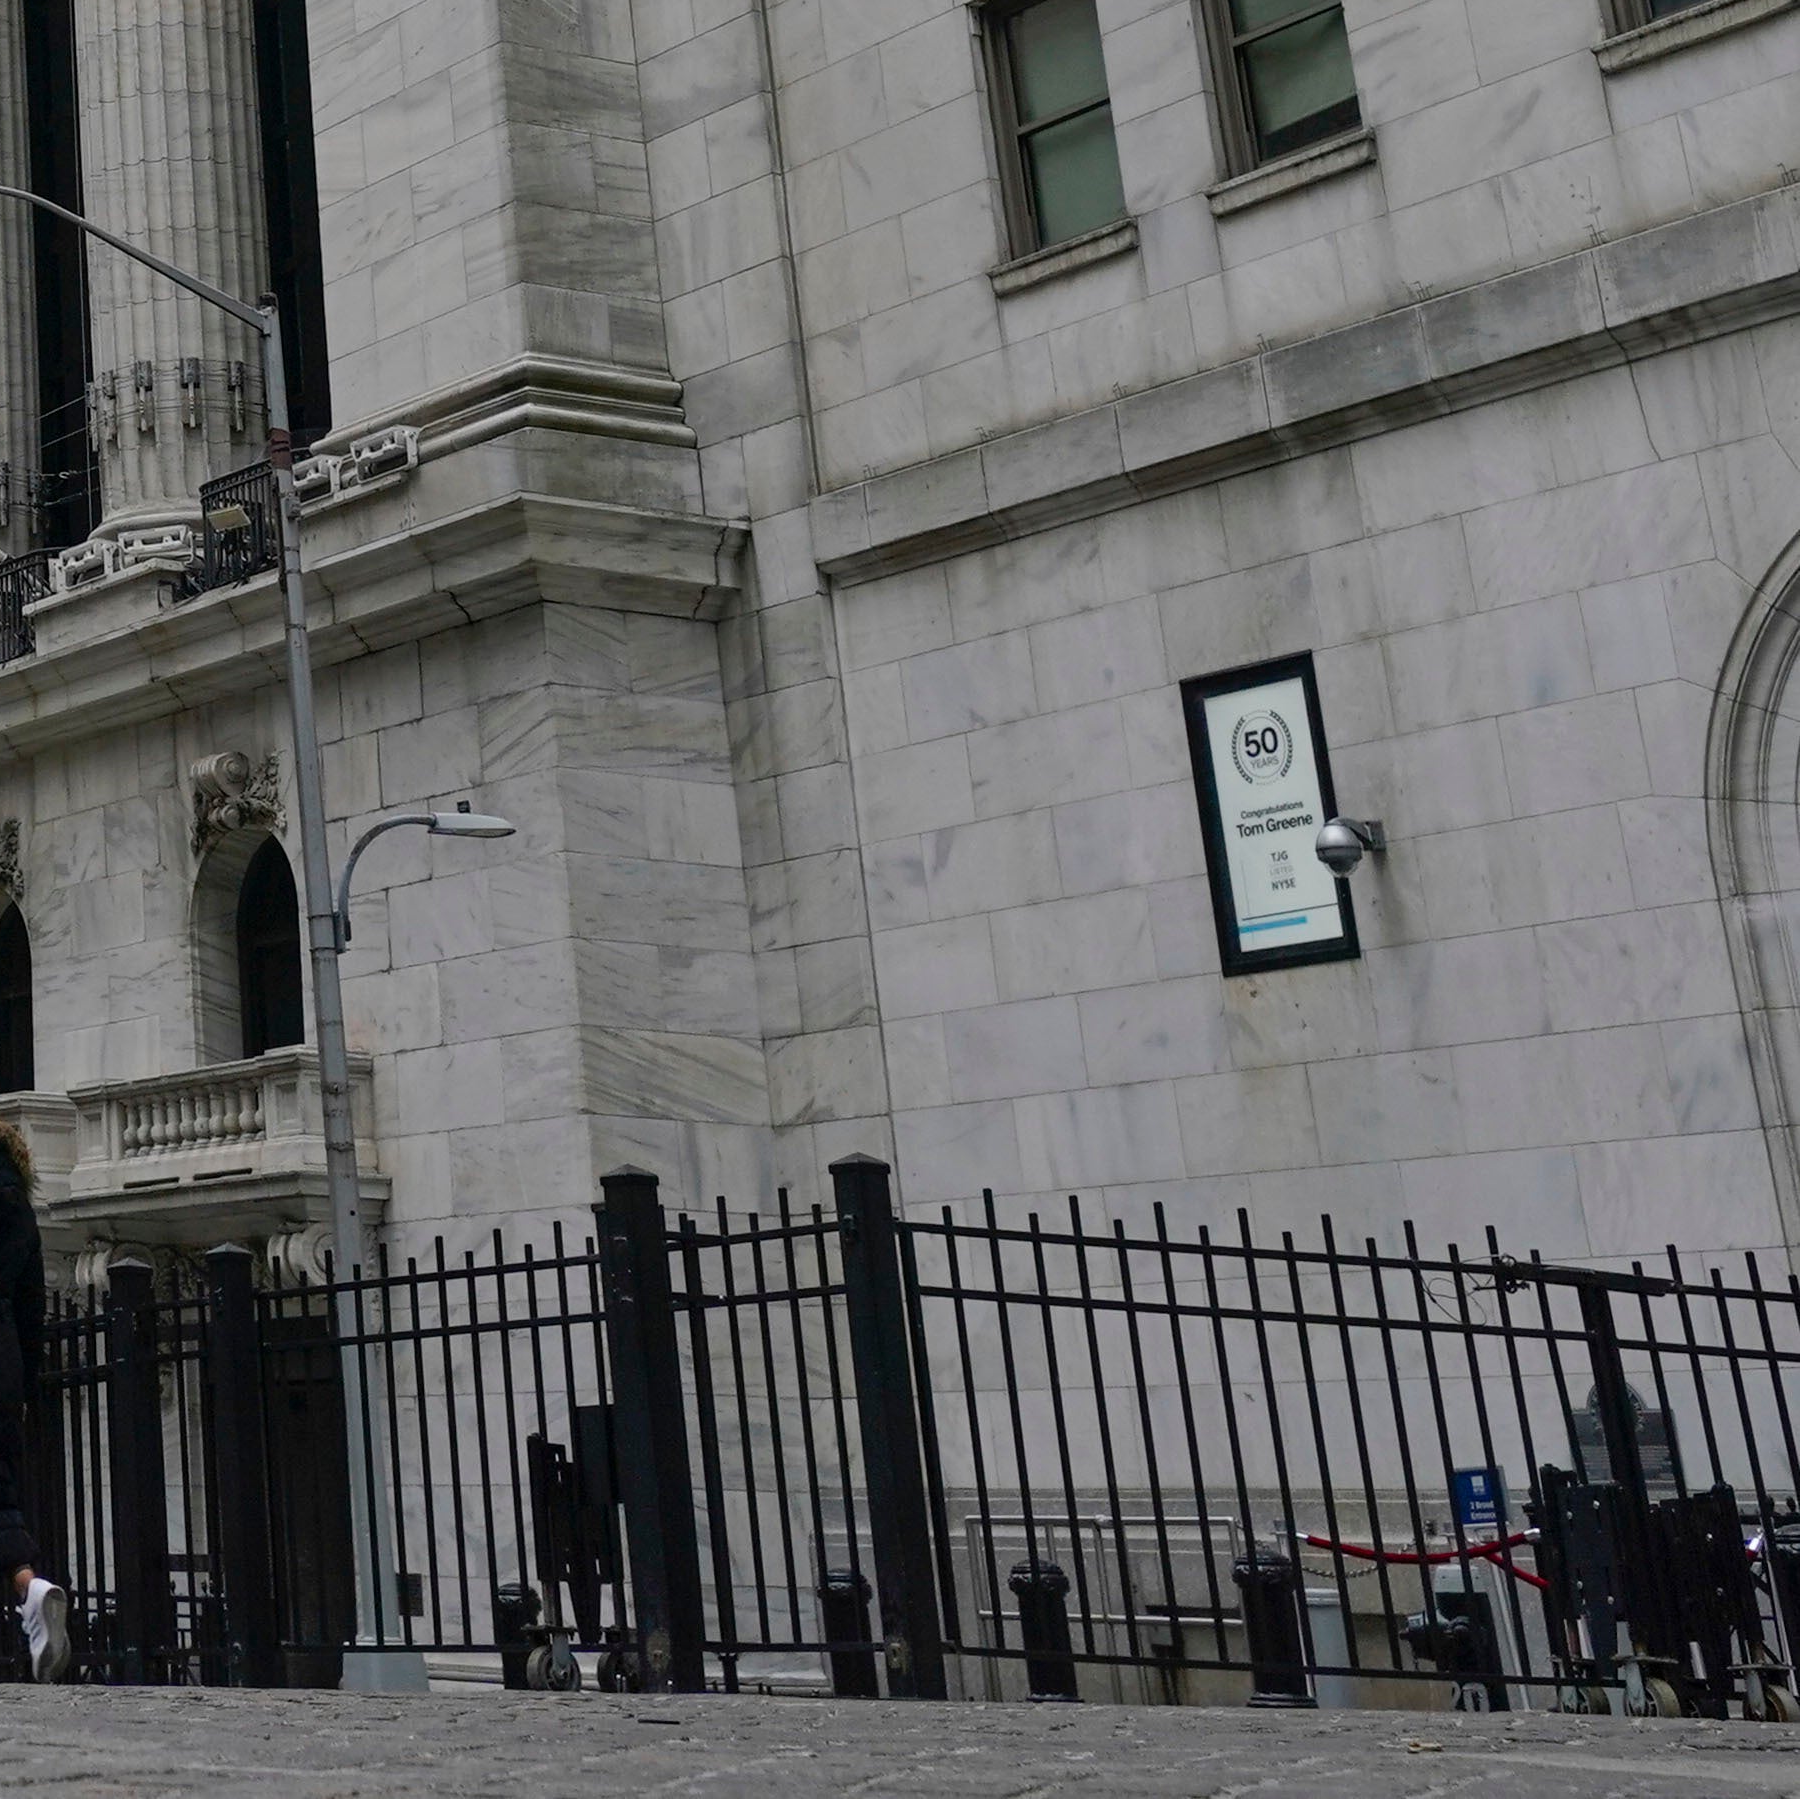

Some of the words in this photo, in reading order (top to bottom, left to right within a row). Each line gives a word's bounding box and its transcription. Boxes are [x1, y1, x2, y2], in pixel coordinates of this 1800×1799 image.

[1244, 727, 1278, 758] 50
[1250, 756, 1280, 769] YEARS
[1241, 801, 1304, 819] Congratulations
[1236, 823, 1264, 838] Tom
[1266, 814, 1313, 832] Greene
[1271, 850, 1289, 862] TJG
[1272, 877, 1296, 891] NYSE
